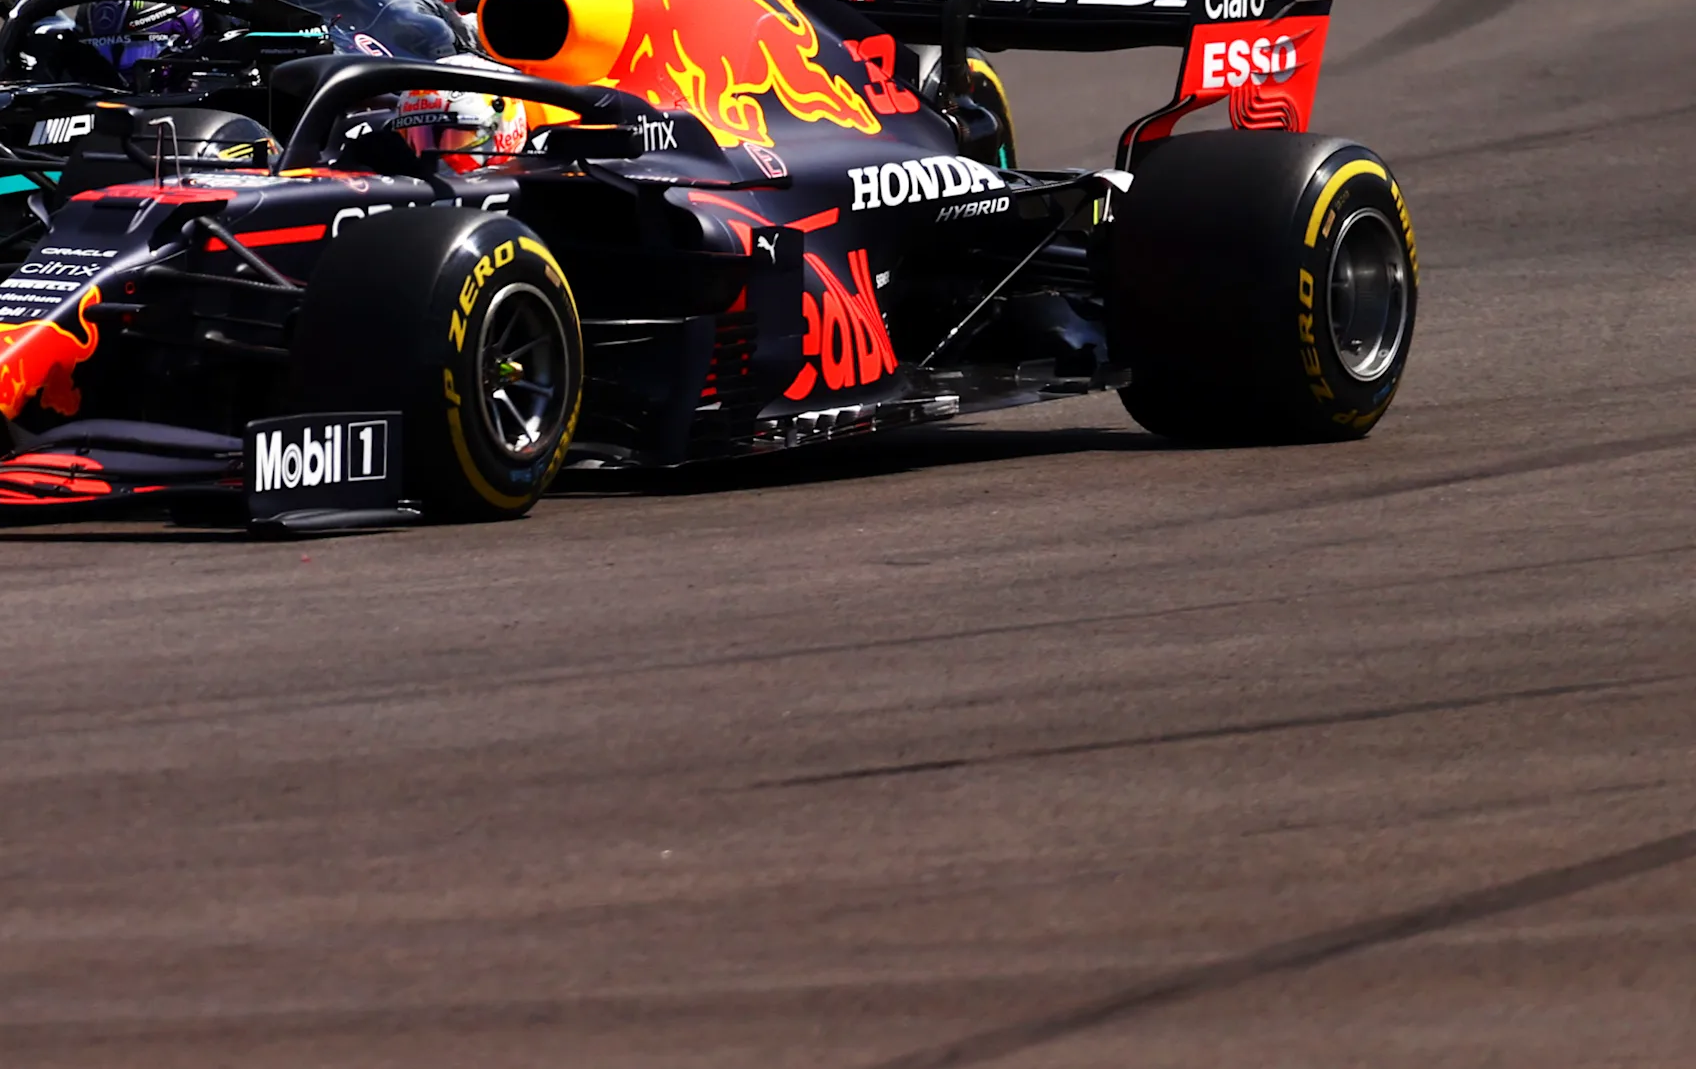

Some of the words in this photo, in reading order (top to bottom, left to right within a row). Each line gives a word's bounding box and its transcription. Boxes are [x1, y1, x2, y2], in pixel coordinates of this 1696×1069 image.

[1202, 35, 1297, 89] ESSO
[394, 114, 451, 128] HONDA
[848, 155, 1006, 211] HONDA
[936, 197, 1009, 223] HYBRID
[20, 261, 101, 277] citrix
[41, 247, 118, 258] ORACLE
[448, 240, 515, 353] ZERO
[1299, 268, 1335, 404] ZERO
[443, 367, 461, 406] P
[255, 424, 342, 493] Mobil
